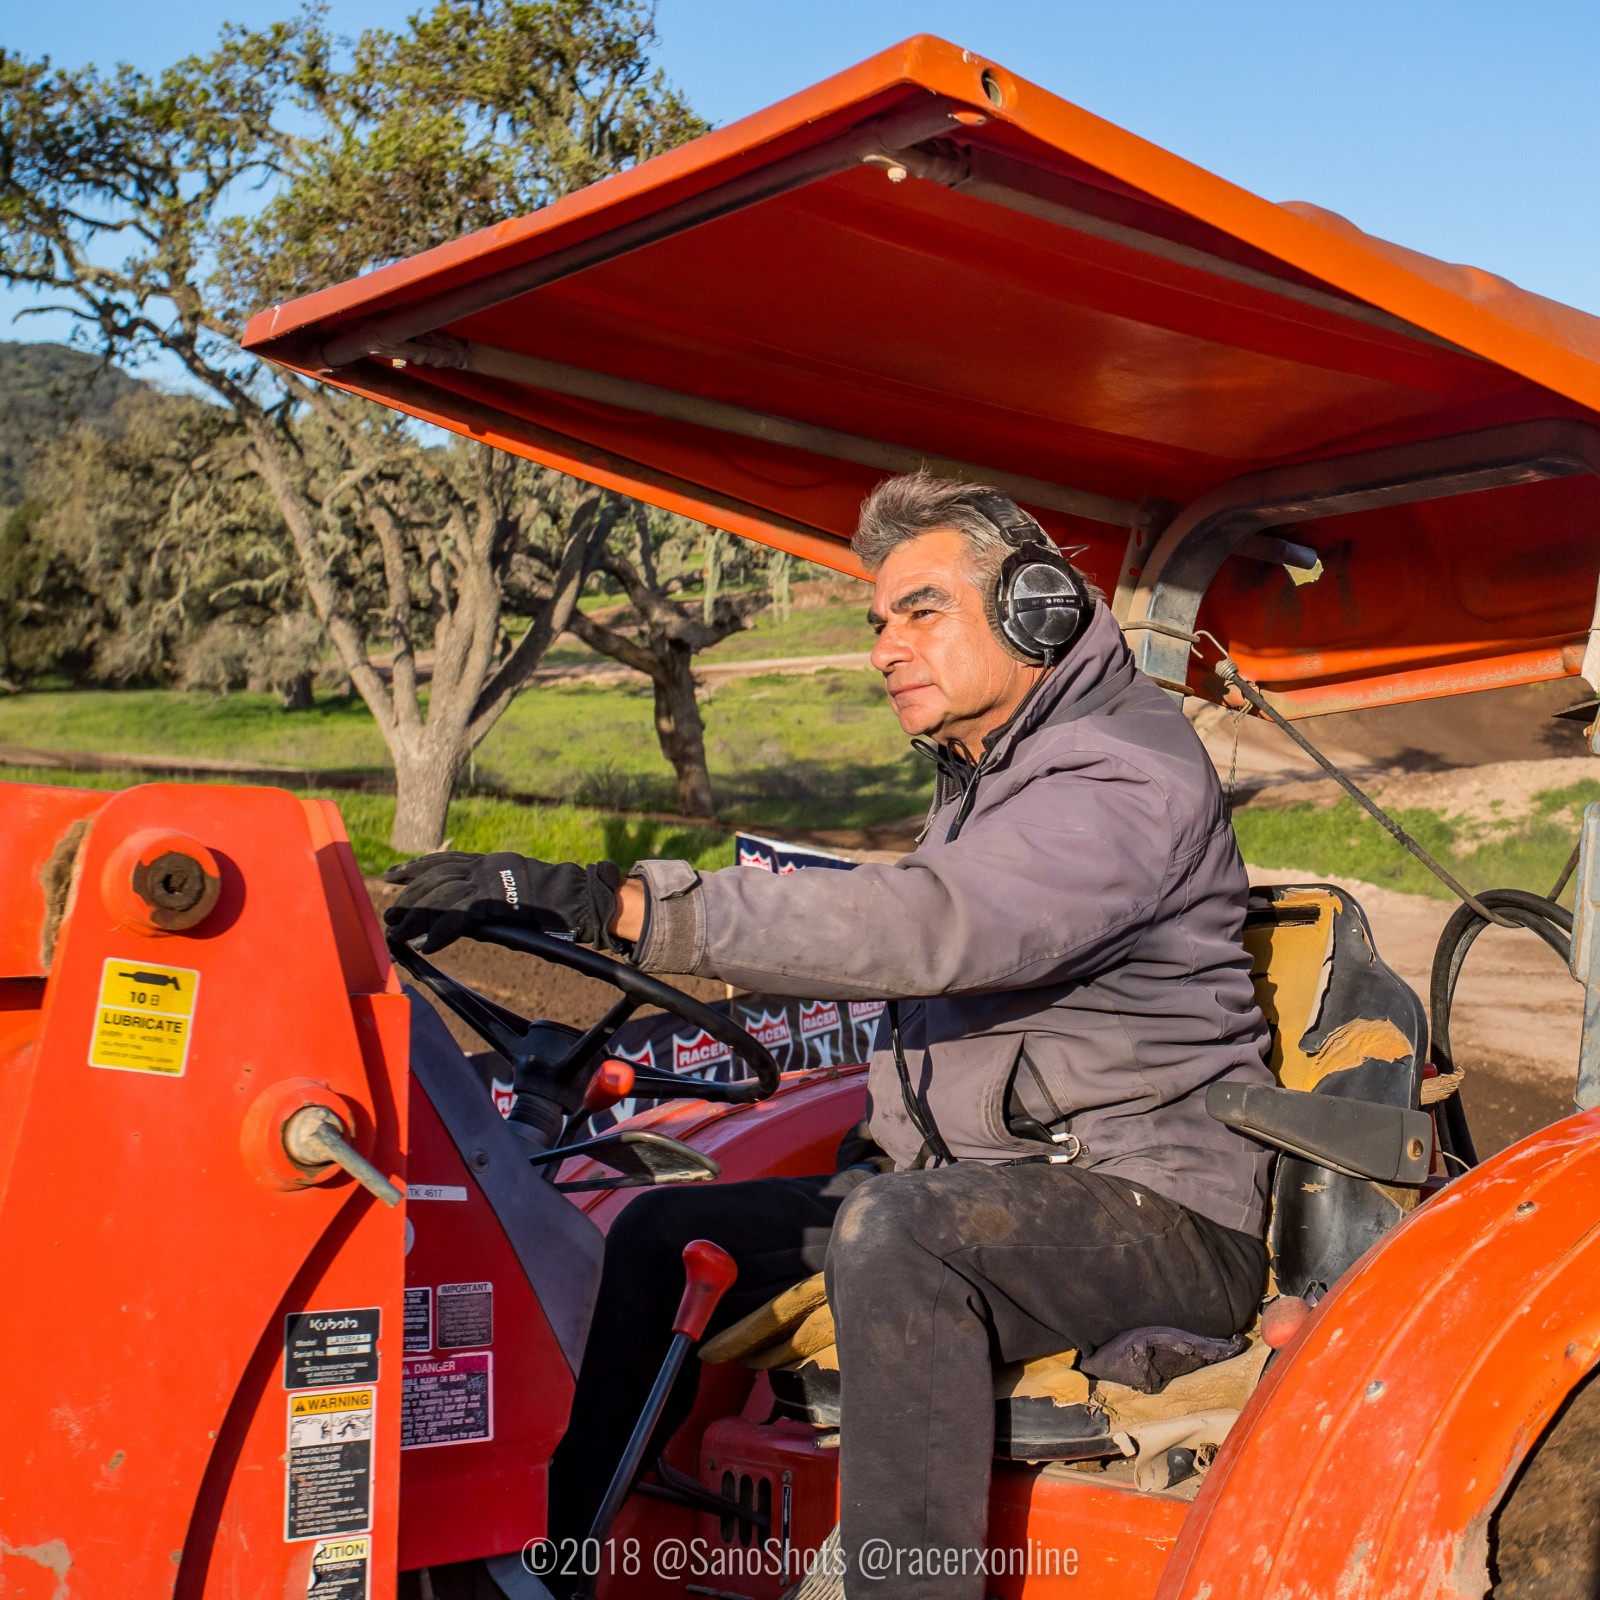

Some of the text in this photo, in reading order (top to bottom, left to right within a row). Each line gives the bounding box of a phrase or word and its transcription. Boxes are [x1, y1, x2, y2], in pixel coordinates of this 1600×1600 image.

[130, 991, 147, 1004] 10
[103, 1013, 183, 1034] LUBRICATE
[803, 1010, 837, 1031] RACER
[678, 1042, 731, 1066] RACER
[408, 1188, 442, 1198] TK 4617
[441, 1283, 489, 1293] IMPORTANT
[309, 1317, 358, 1331] Kubota
[414, 1361, 456, 1374] DANGER
[308, 1394, 369, 1410] WARNING
[317, 1544, 364, 1560] AUTION
